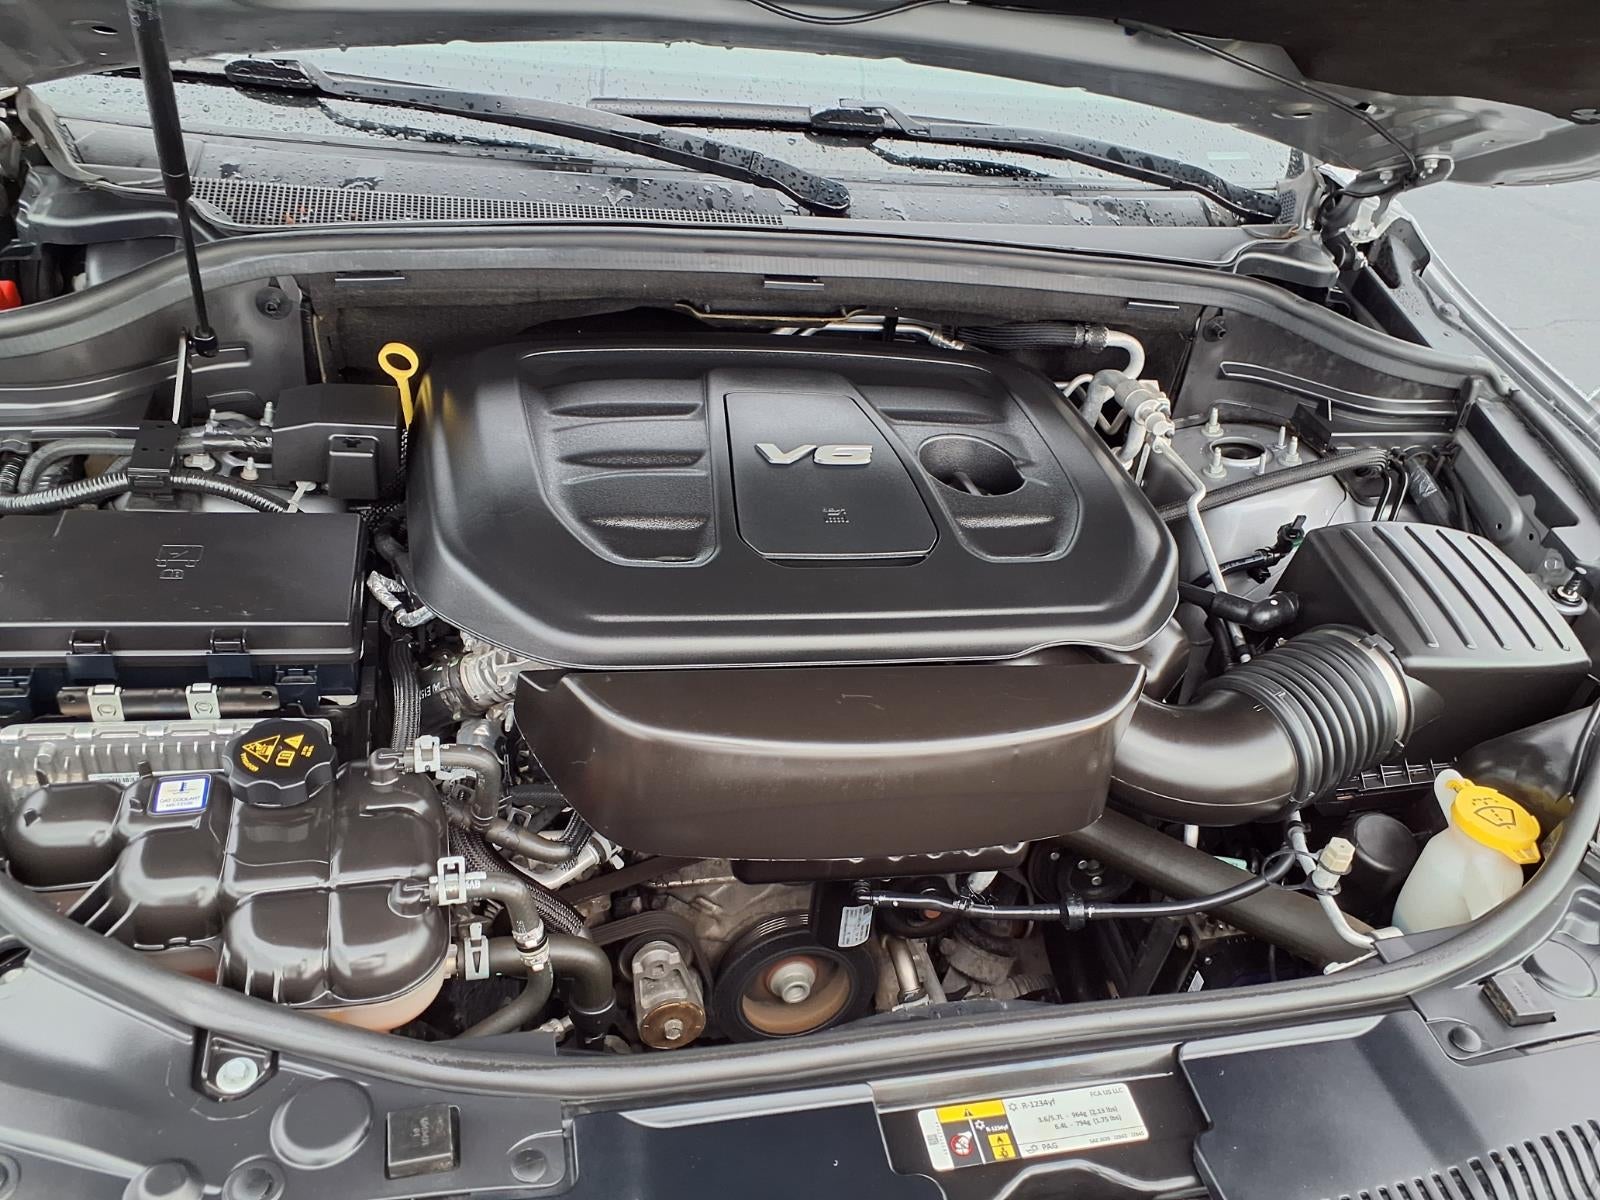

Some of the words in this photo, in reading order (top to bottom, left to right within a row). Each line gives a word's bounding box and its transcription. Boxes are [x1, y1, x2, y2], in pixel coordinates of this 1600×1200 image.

[754, 442, 873, 466] V6
[1022, 1098, 1056, 1109] R-1234yf
[1041, 1143, 1059, 1151] PAG
